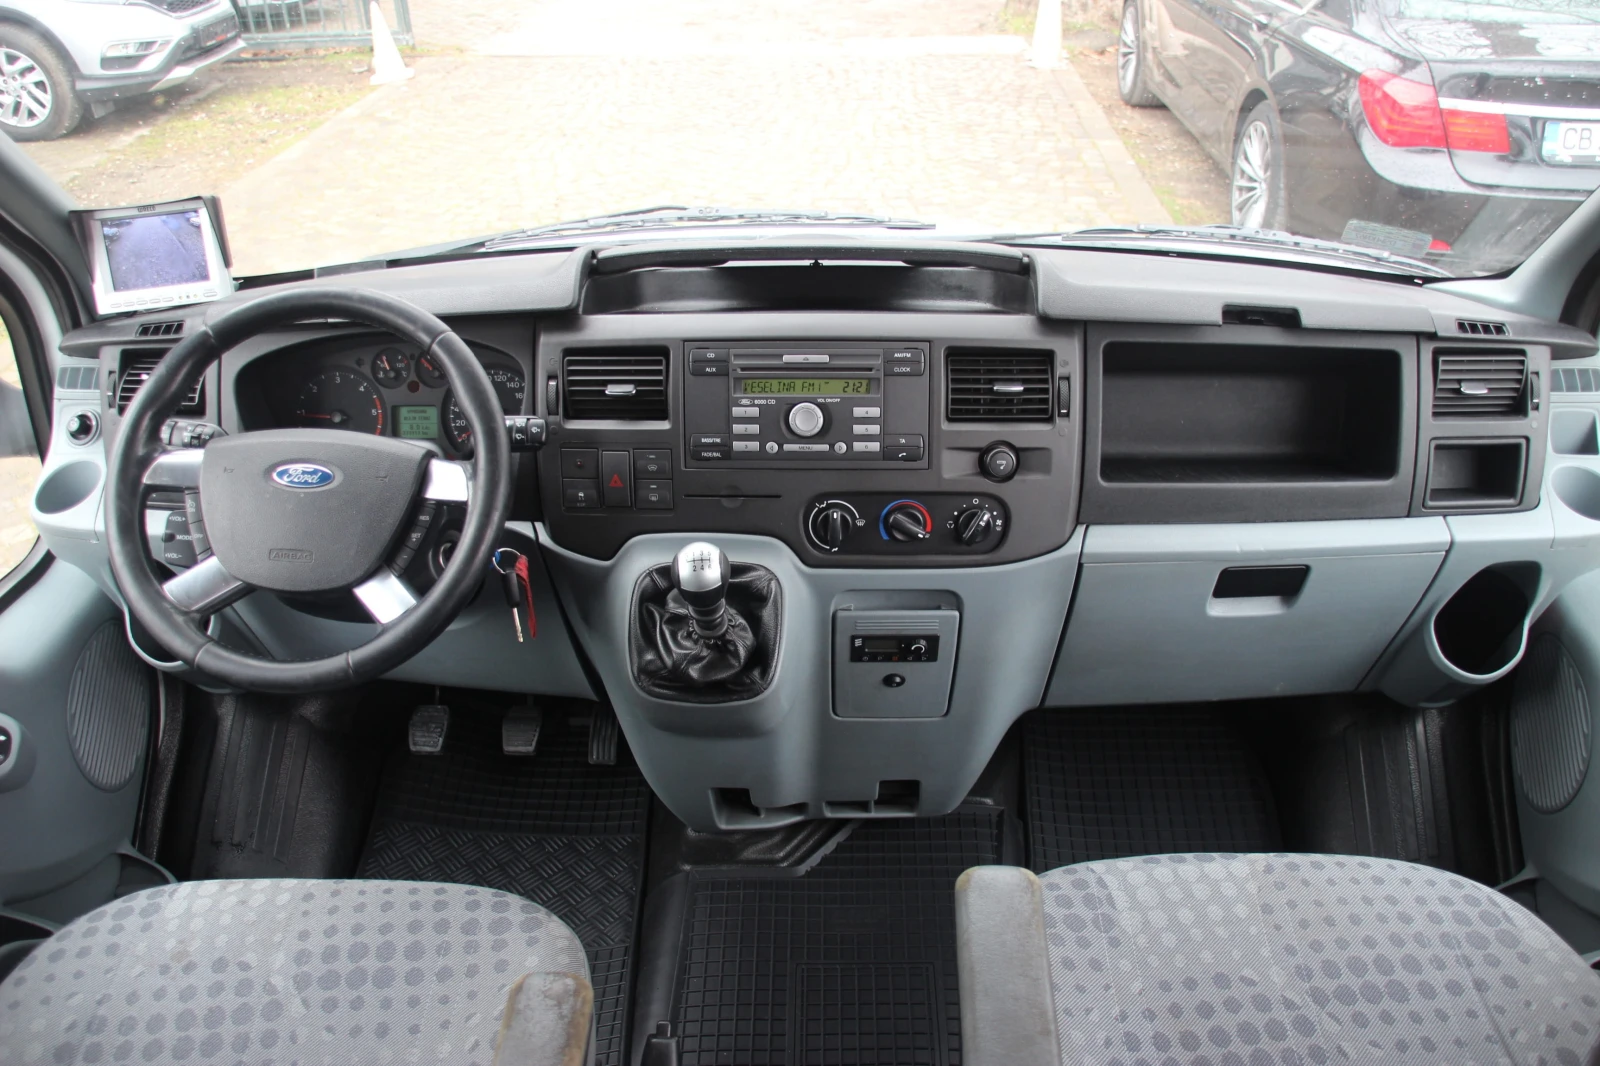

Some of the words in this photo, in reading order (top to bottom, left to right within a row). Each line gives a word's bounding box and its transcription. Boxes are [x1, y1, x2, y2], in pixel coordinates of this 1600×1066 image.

[1563, 128, 1592, 150] CB
[335, 376, 341, 384] 3
[494, 374, 507, 382] 120
[744, 381, 796, 393] VESELINA
[515, 392, 525, 400] 16
[371, 408, 377, 416] 5
[455, 419, 466, 427] 20
[283, 467, 322, 483] Ford
[272, 551, 313, 561] AIRBAG
[699, 564, 705, 572] 4
